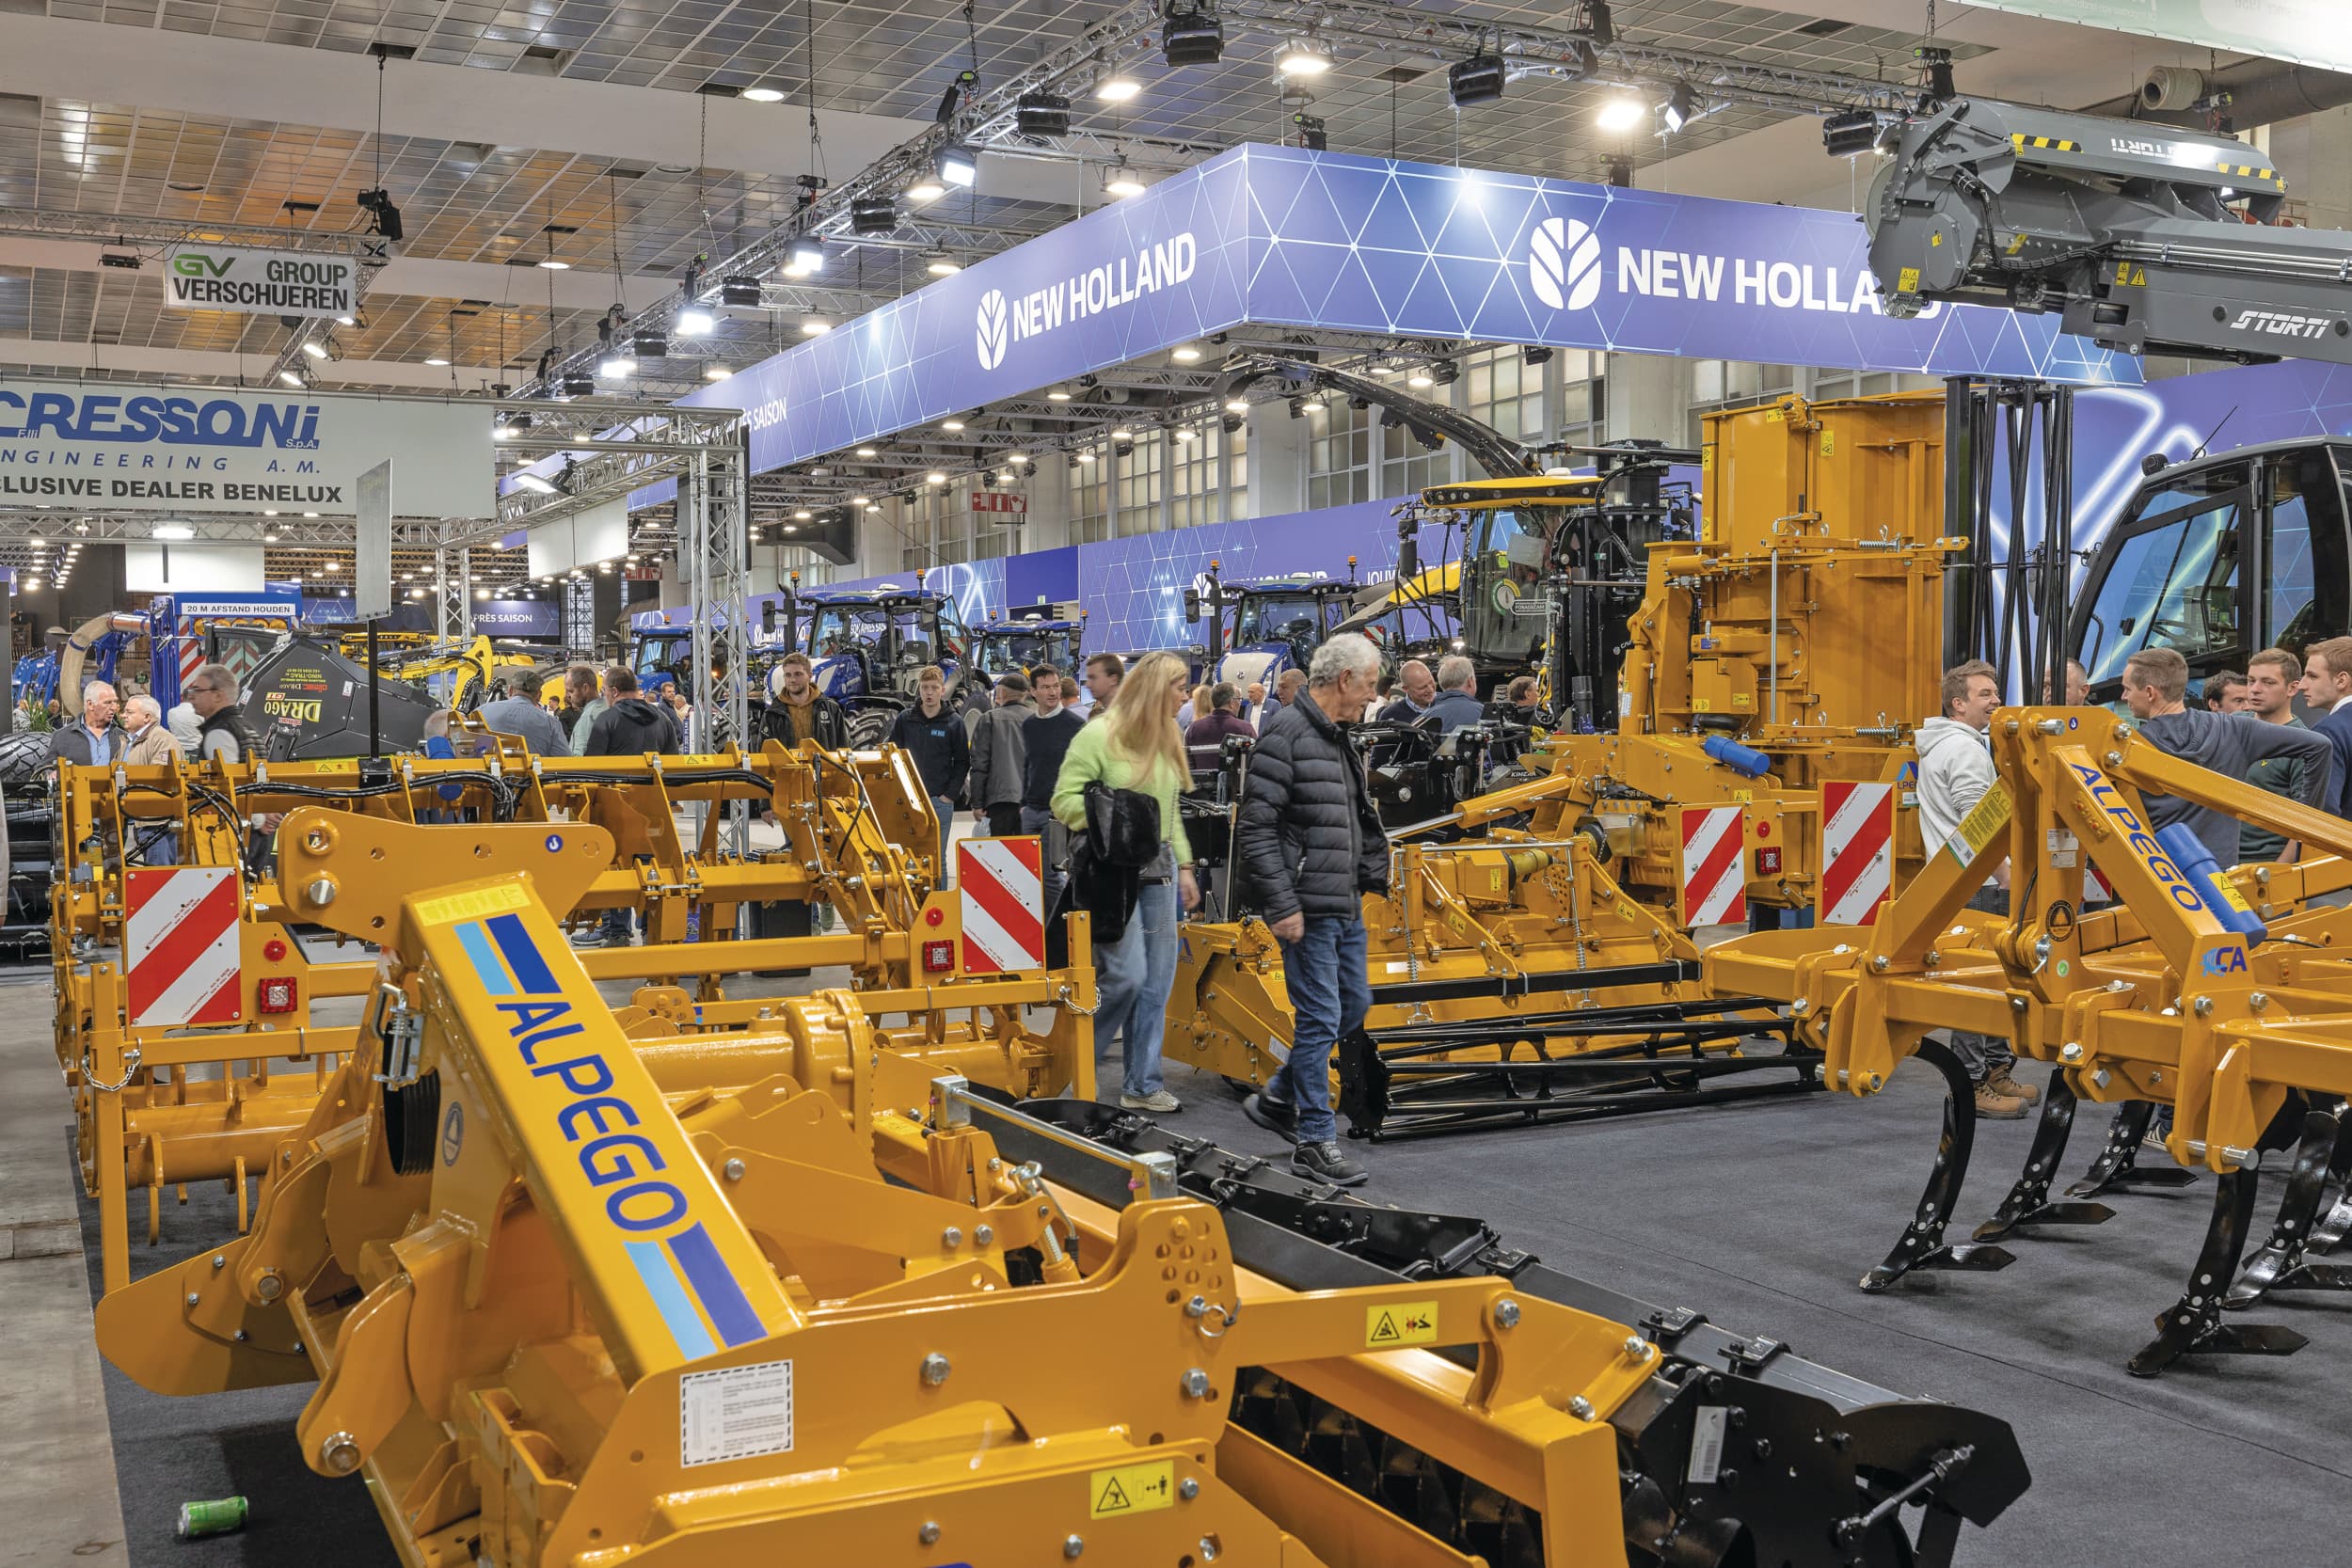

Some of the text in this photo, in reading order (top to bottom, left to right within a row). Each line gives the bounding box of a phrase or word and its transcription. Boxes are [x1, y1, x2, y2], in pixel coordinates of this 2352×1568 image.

[174, 253, 348, 286] GV GROUP
[1617, 246, 1942, 320] NEW HOLLA
[173, 277, 348, 311] VERSCHUEREN
[1013, 232, 1197, 342] NEW HOLLAND
[2230, 310, 2331, 340] STORTI
[753, 396, 787, 432] SAISON
[0, 449, 229, 471] NGINEERING
[0, 476, 342, 504] LUSIVE DEALER BENELUX
[470, 612, 533, 623] PRÈS SAISON
[264, 701, 322, 723] DRAGO
[2070, 763, 2203, 911] ALPEGO
[2216, 946, 2249, 973] CA
[494, 1001, 689, 1232] ALPEGO
